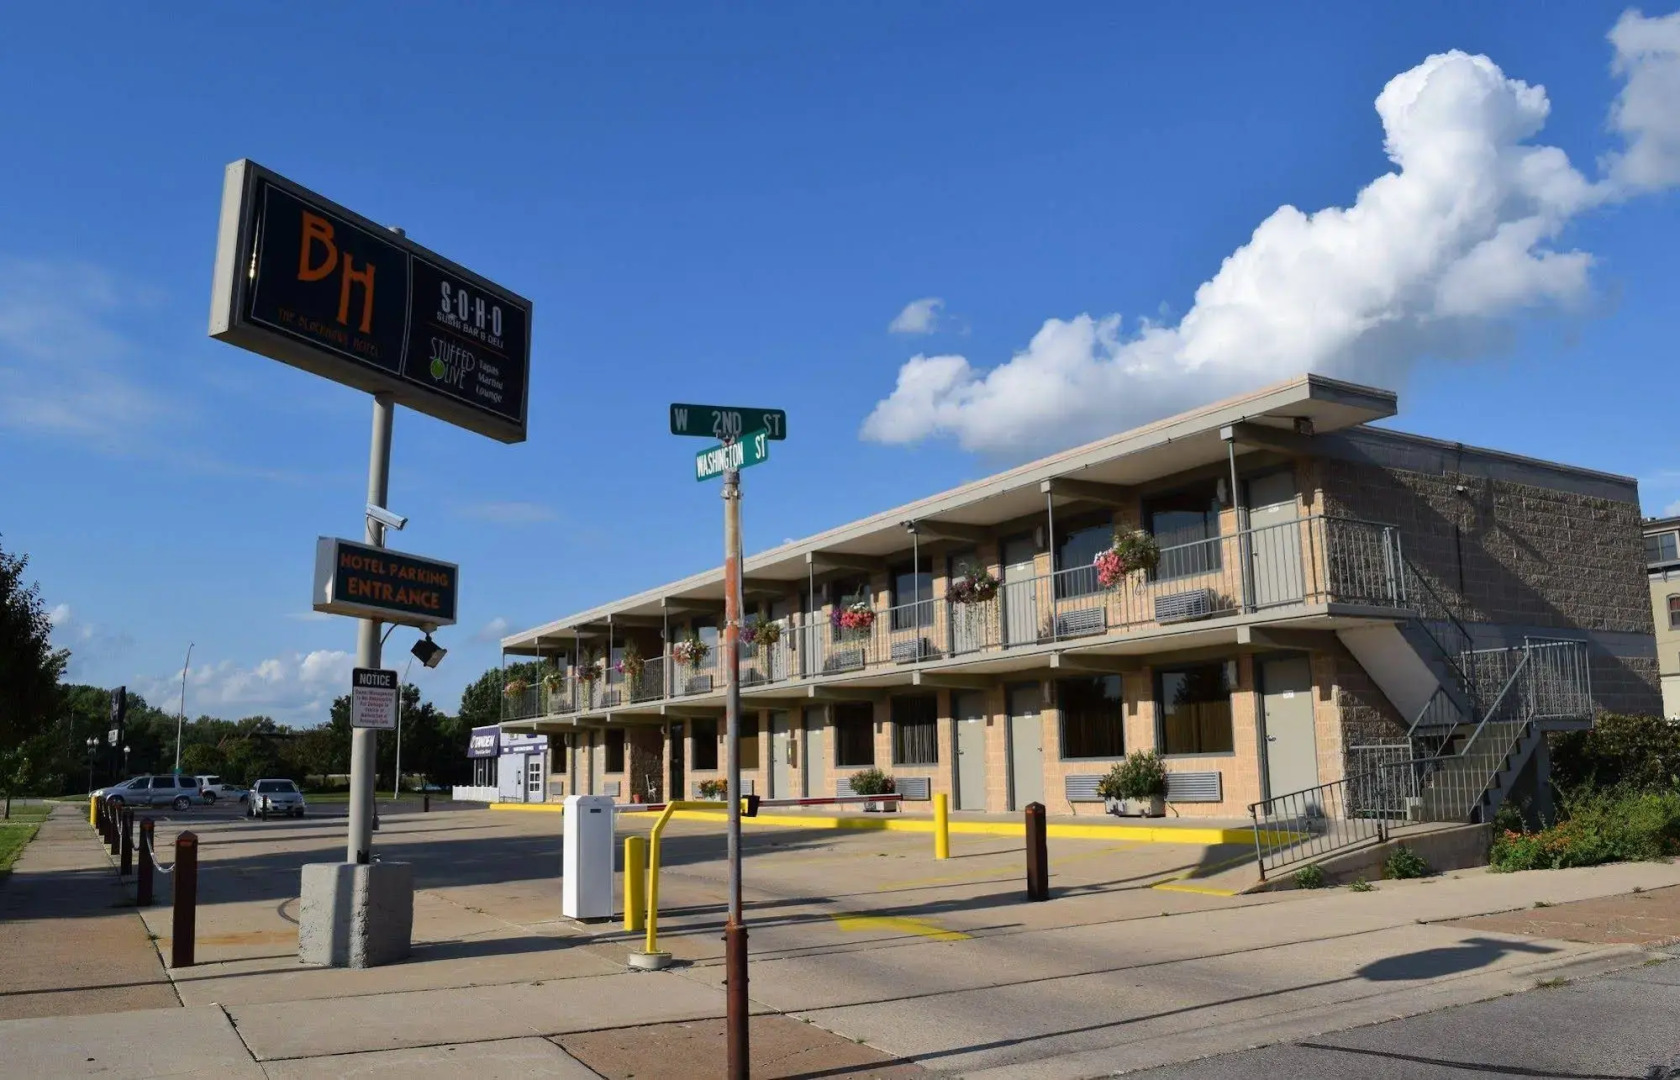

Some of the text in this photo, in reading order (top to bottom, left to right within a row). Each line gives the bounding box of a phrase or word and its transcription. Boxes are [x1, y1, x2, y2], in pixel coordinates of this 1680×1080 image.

[436, 311, 461, 329] SUSHI
[462, 323, 479, 338] BAR
[487, 334, 504, 349] DELI
[429, 336, 476, 372] STUFFED
[475, 384, 503, 403] Lounge
[674, 408, 781, 436] W 2ND ST
[696, 433, 766, 478] WASHINGTON ST
[341, 552, 449, 587] HOTEL PARKING
[347, 577, 441, 609] ENTRANCE
[360, 673, 391, 686] NOTICE
